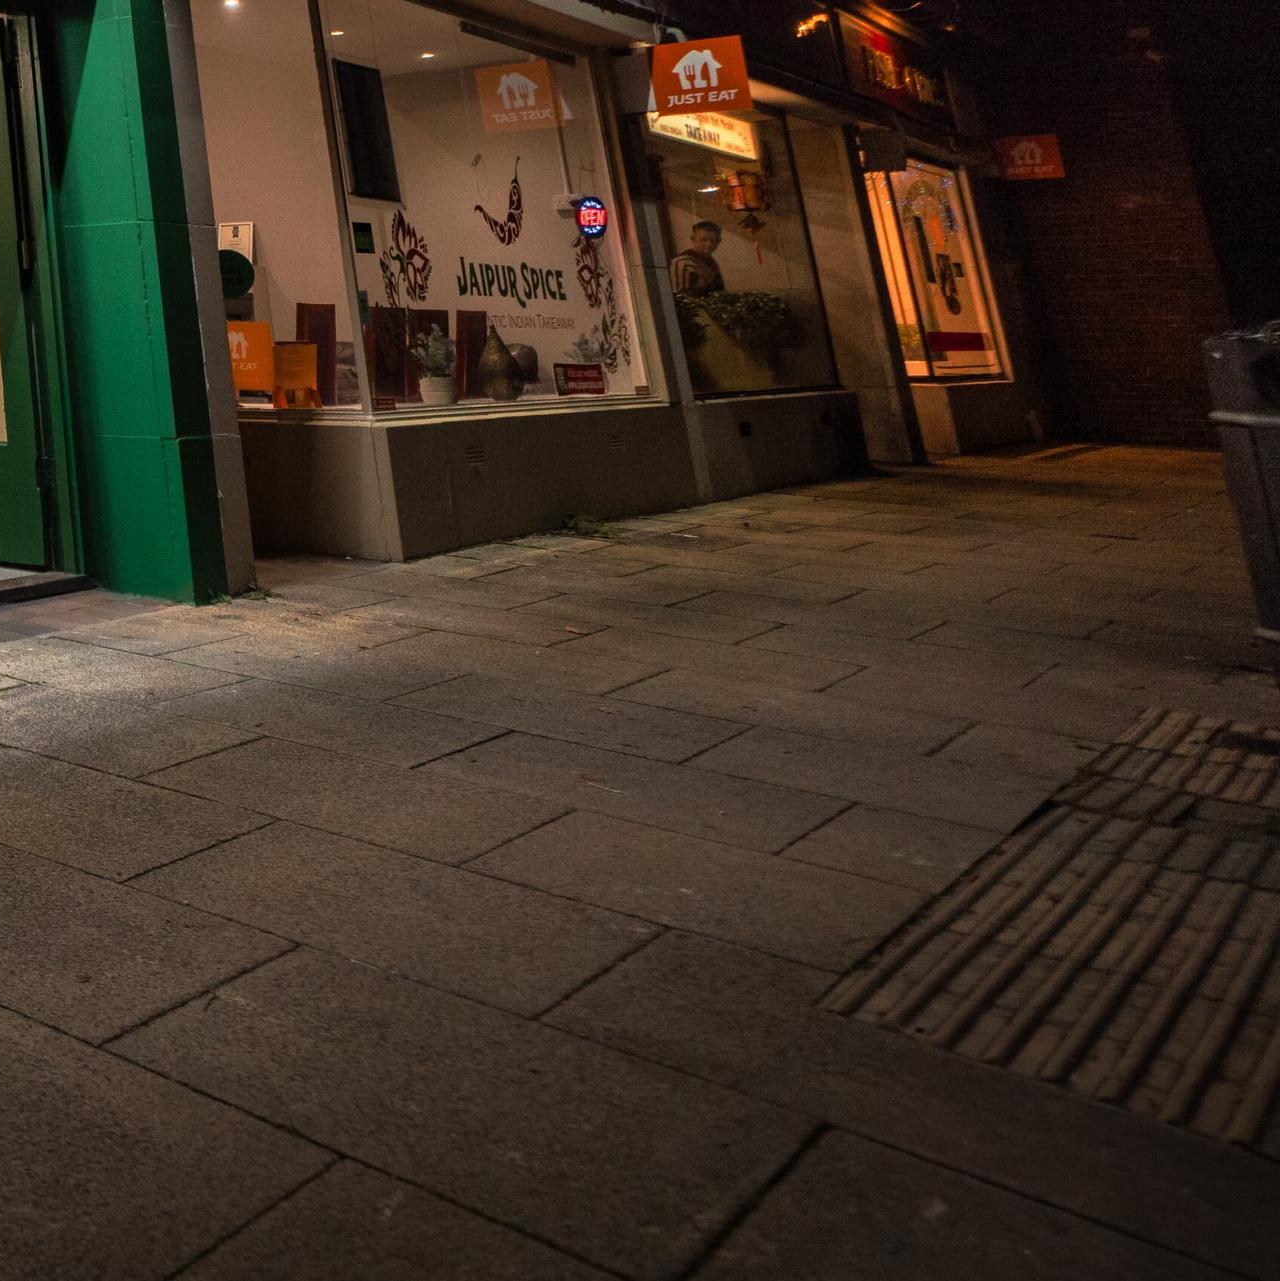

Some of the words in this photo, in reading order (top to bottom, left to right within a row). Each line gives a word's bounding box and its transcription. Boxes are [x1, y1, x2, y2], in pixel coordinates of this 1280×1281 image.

[666, 91, 705, 108] JUST
[707, 88, 739, 103] EAT
[455, 255, 527, 309] JAIPUR
[519, 261, 568, 301] SPICE
